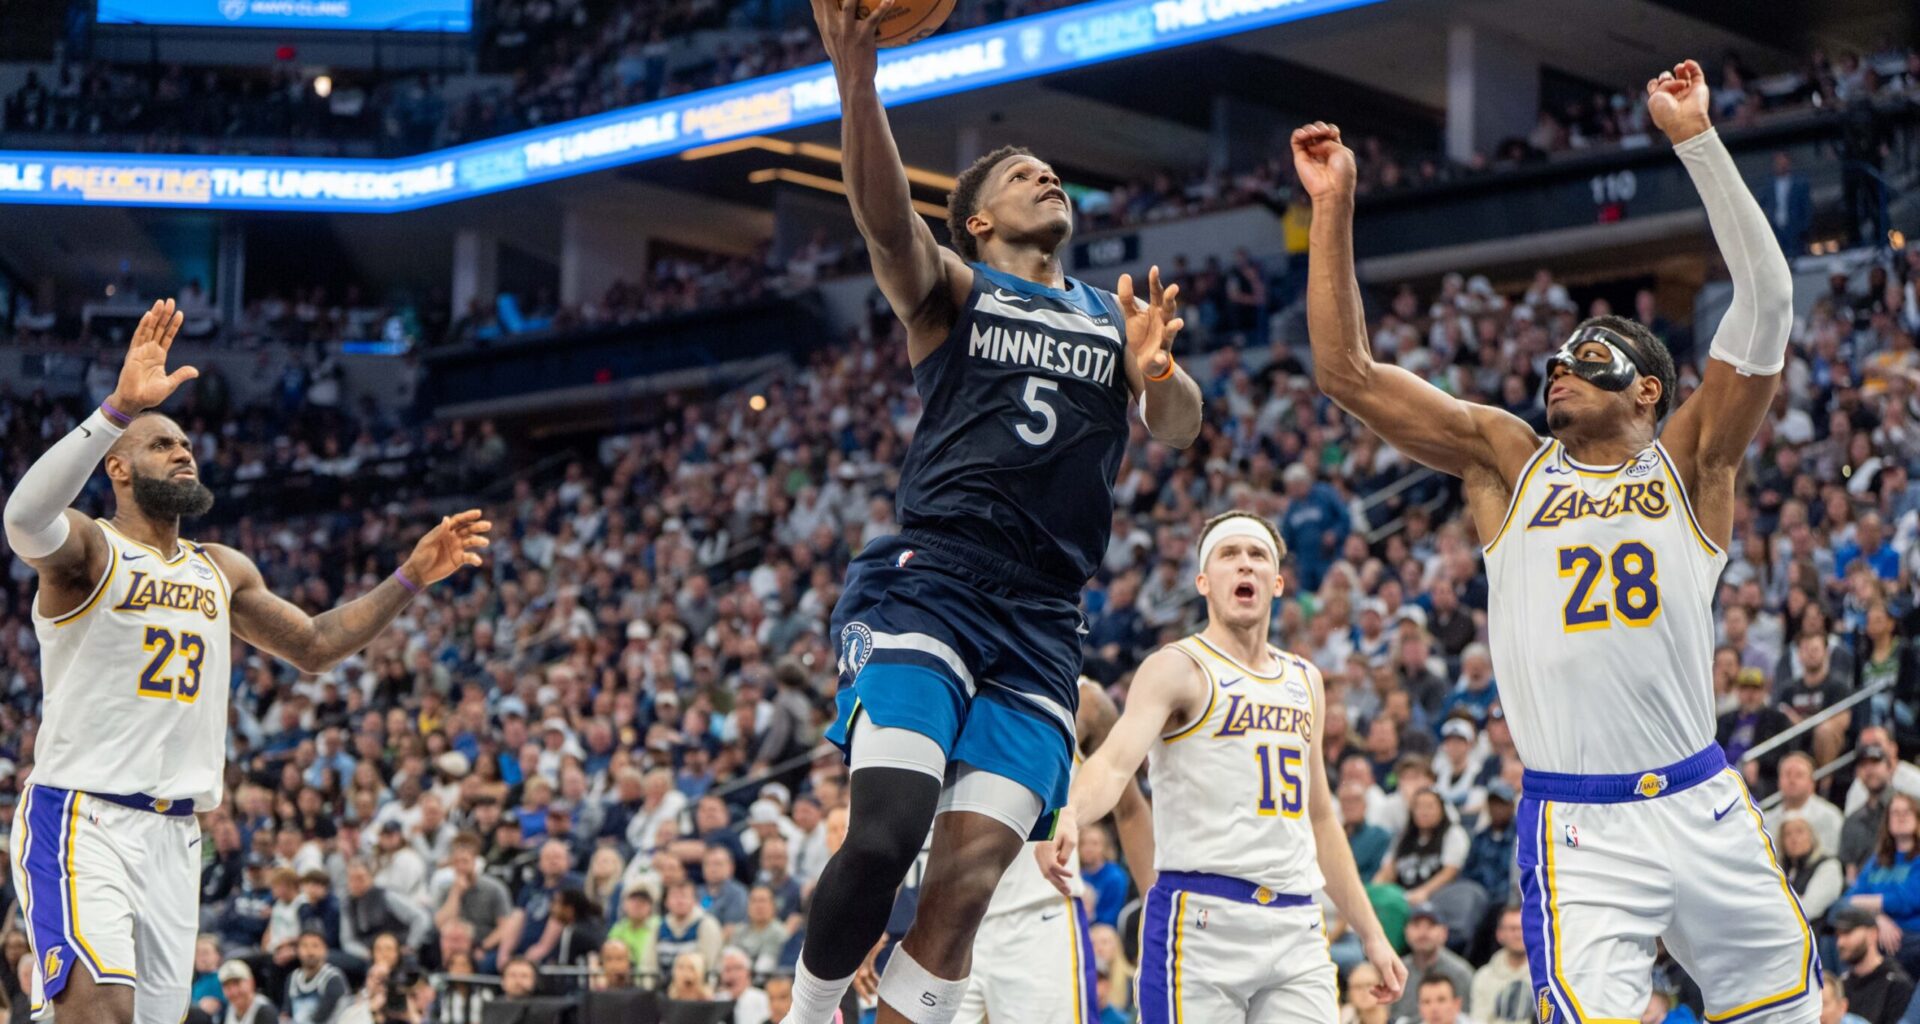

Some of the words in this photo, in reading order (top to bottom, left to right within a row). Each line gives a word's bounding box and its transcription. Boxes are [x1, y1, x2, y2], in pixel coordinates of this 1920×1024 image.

[968, 322, 1116, 388] MINNESOTA
[1015, 376, 1059, 445] 5
[1526, 479, 1671, 530] LAKERS
[112, 570, 219, 621] LAKERS
[1557, 539, 1662, 633] 28
[137, 624, 207, 704] 23
[1213, 694, 1314, 745] LAKERS
[1255, 743, 1305, 819] 15
[919, 991, 938, 1008] 5
